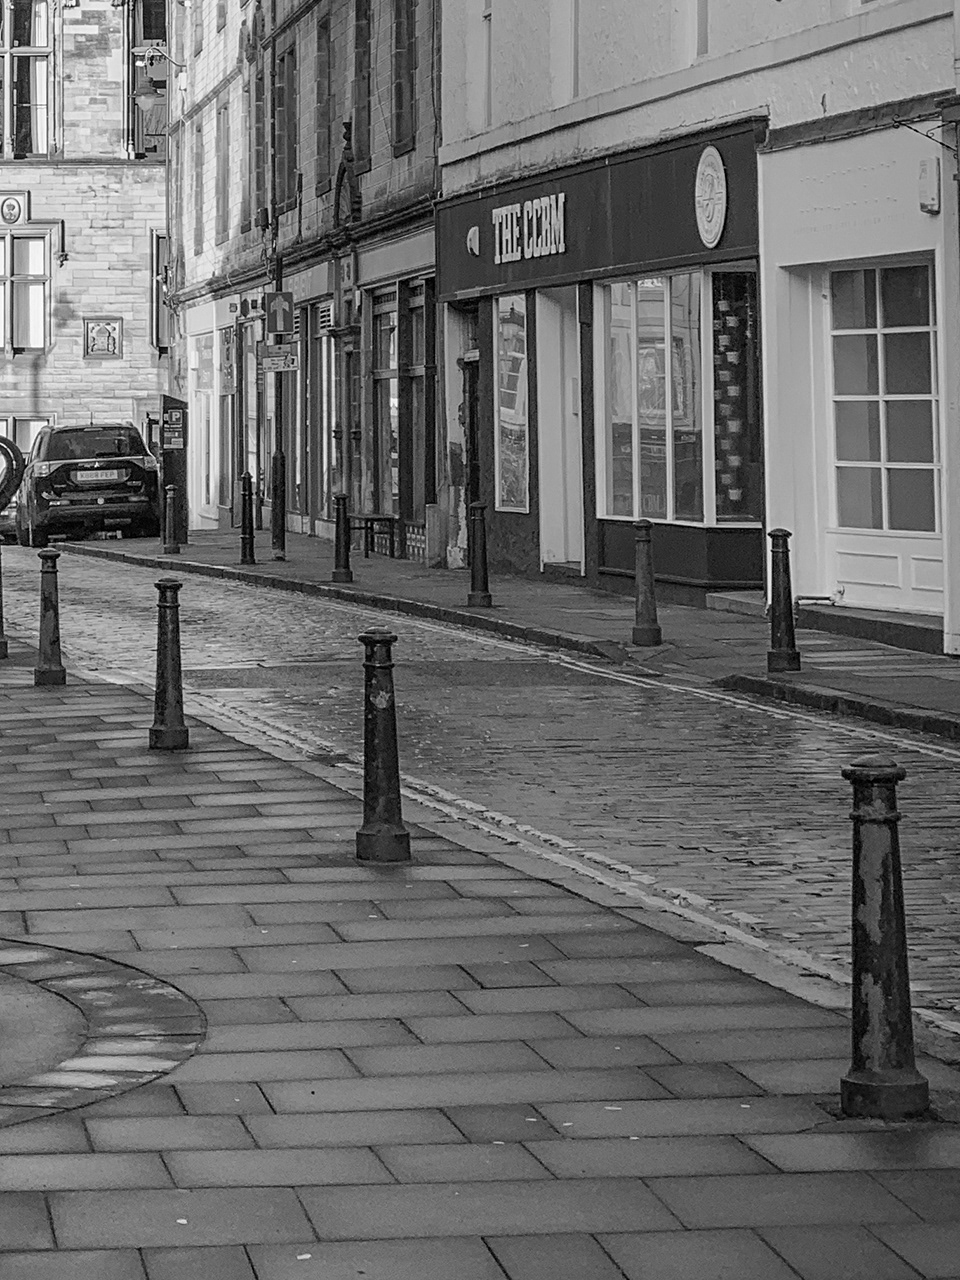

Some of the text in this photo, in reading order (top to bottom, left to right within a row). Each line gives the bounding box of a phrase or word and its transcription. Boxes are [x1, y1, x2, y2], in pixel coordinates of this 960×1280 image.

[491, 192, 566, 265] THE CCBM
[171, 411, 180, 421] P
